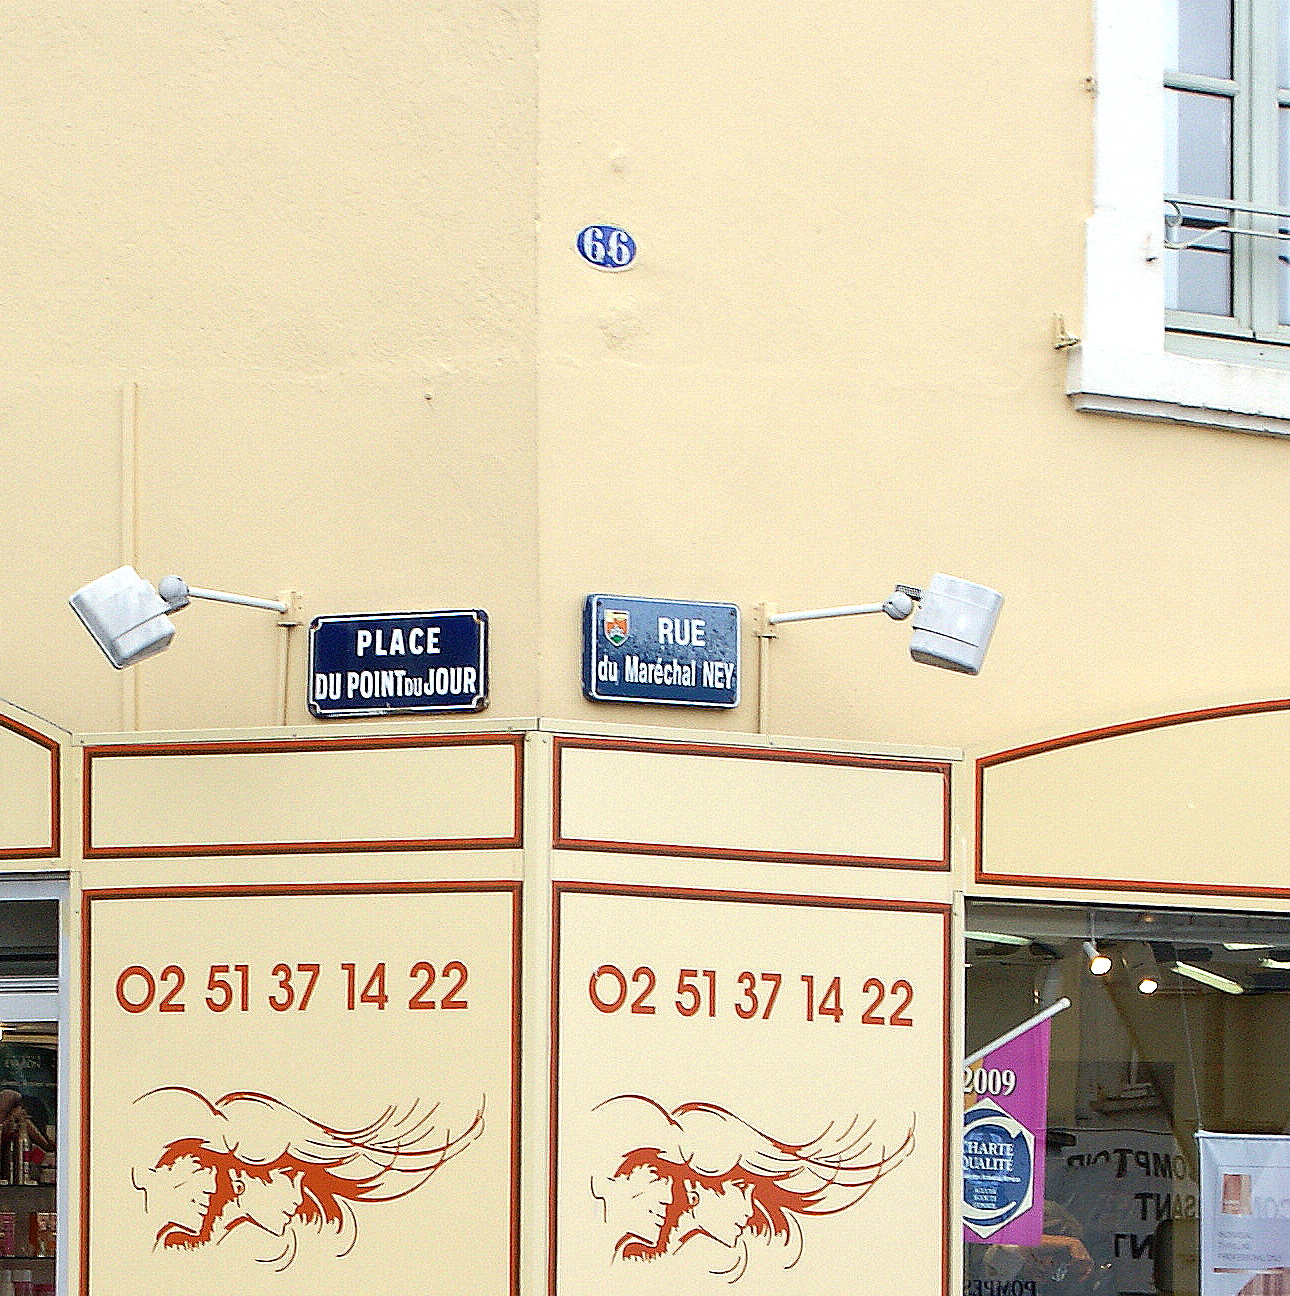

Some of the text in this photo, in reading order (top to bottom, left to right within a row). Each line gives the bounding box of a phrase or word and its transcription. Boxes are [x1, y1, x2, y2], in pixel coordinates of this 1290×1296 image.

[583, 227, 631, 265] 66
[357, 627, 441, 657] PLACE
[658, 616, 707, 648] RUE
[315, 672, 341, 701] DU
[347, 669, 406, 700] POINT
[424, 665, 477, 696] JOUR
[598, 655, 734, 689] du Maréchal NEY
[116, 961, 470, 1014] 02 51 37 14 22
[589, 965, 915, 1028] 02 51 37 14 22
[964, 1068, 1017, 1096] 2009
[964, 1141, 1014, 1156] HARTE
